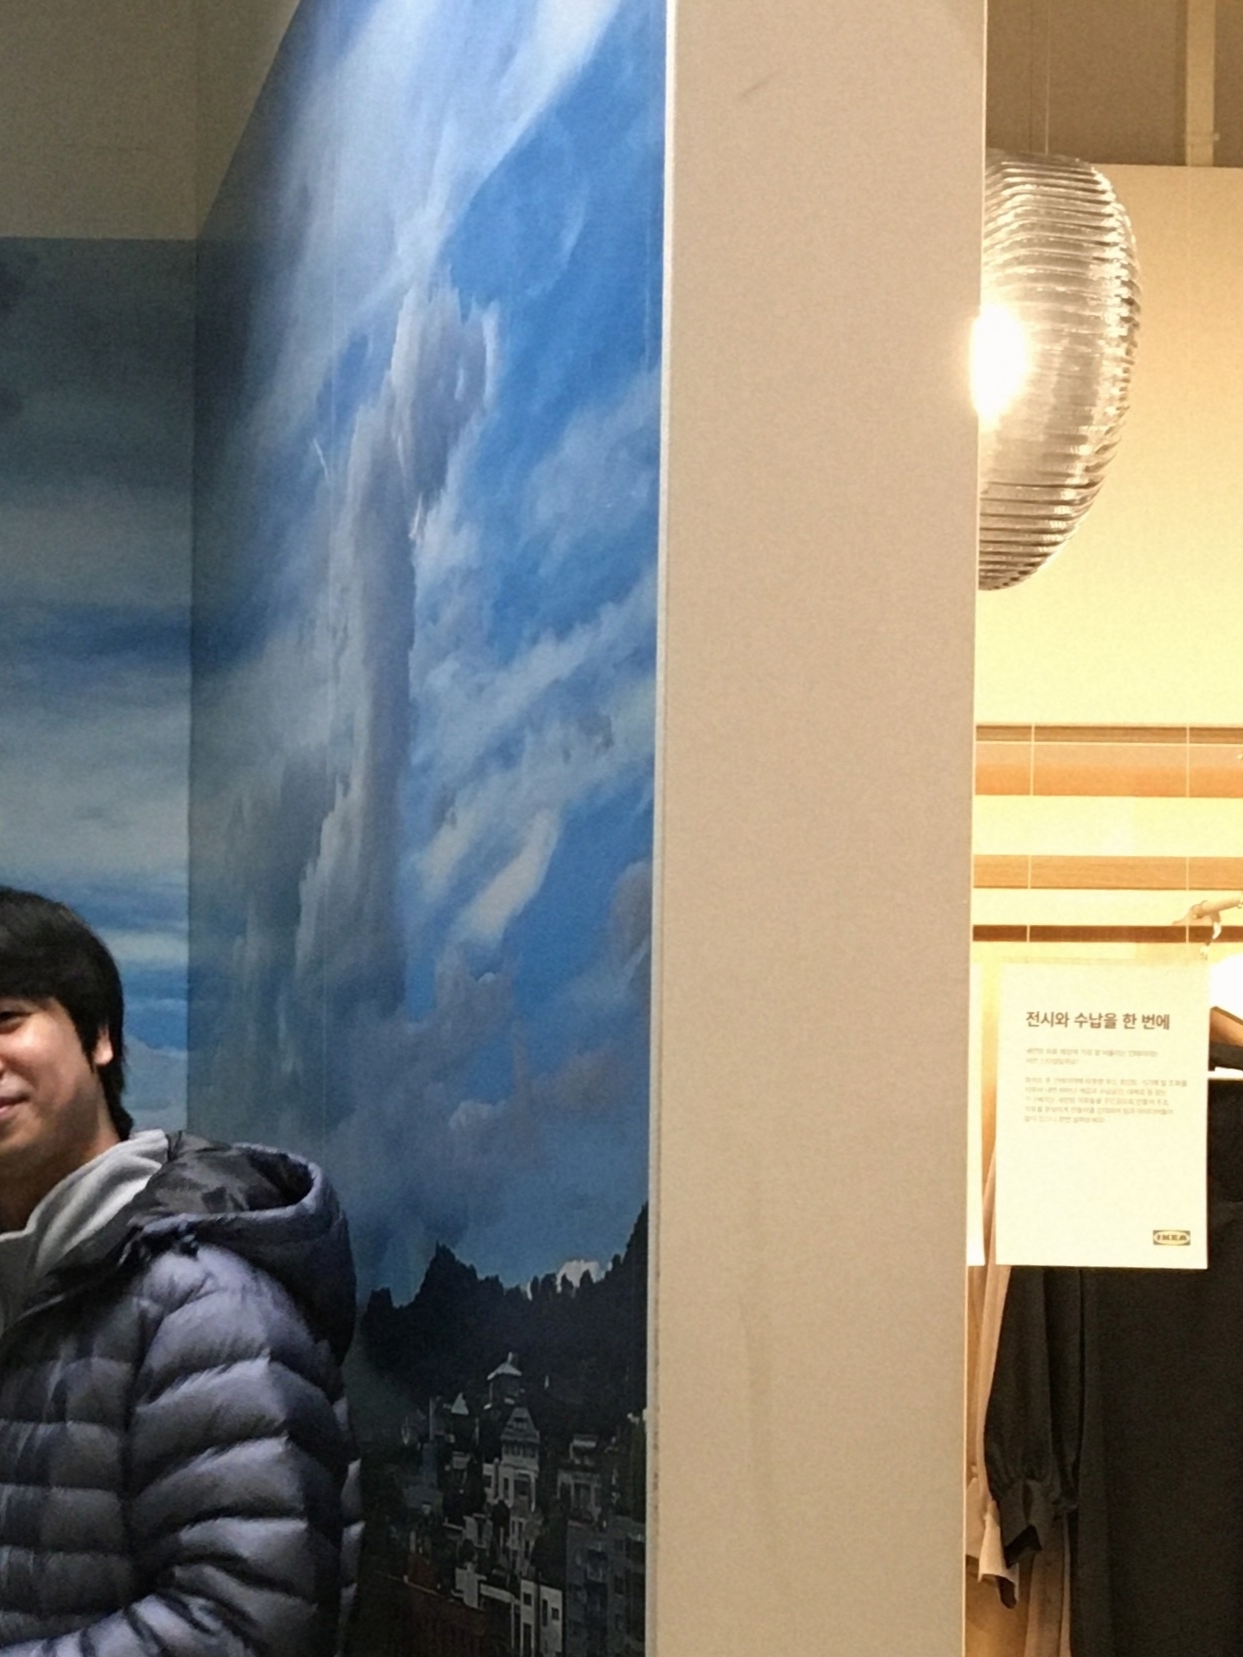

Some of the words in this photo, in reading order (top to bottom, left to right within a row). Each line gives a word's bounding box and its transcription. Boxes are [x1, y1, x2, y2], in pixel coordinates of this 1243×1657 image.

[1026, 1011, 1070, 1029] 전시와
[1074, 1012, 1118, 1029] 수납을
[1122, 1013, 1138, 1030] 한
[1141, 1013, 1171, 1031] 번에
[1155, 1232, 1189, 1243] IKEA
